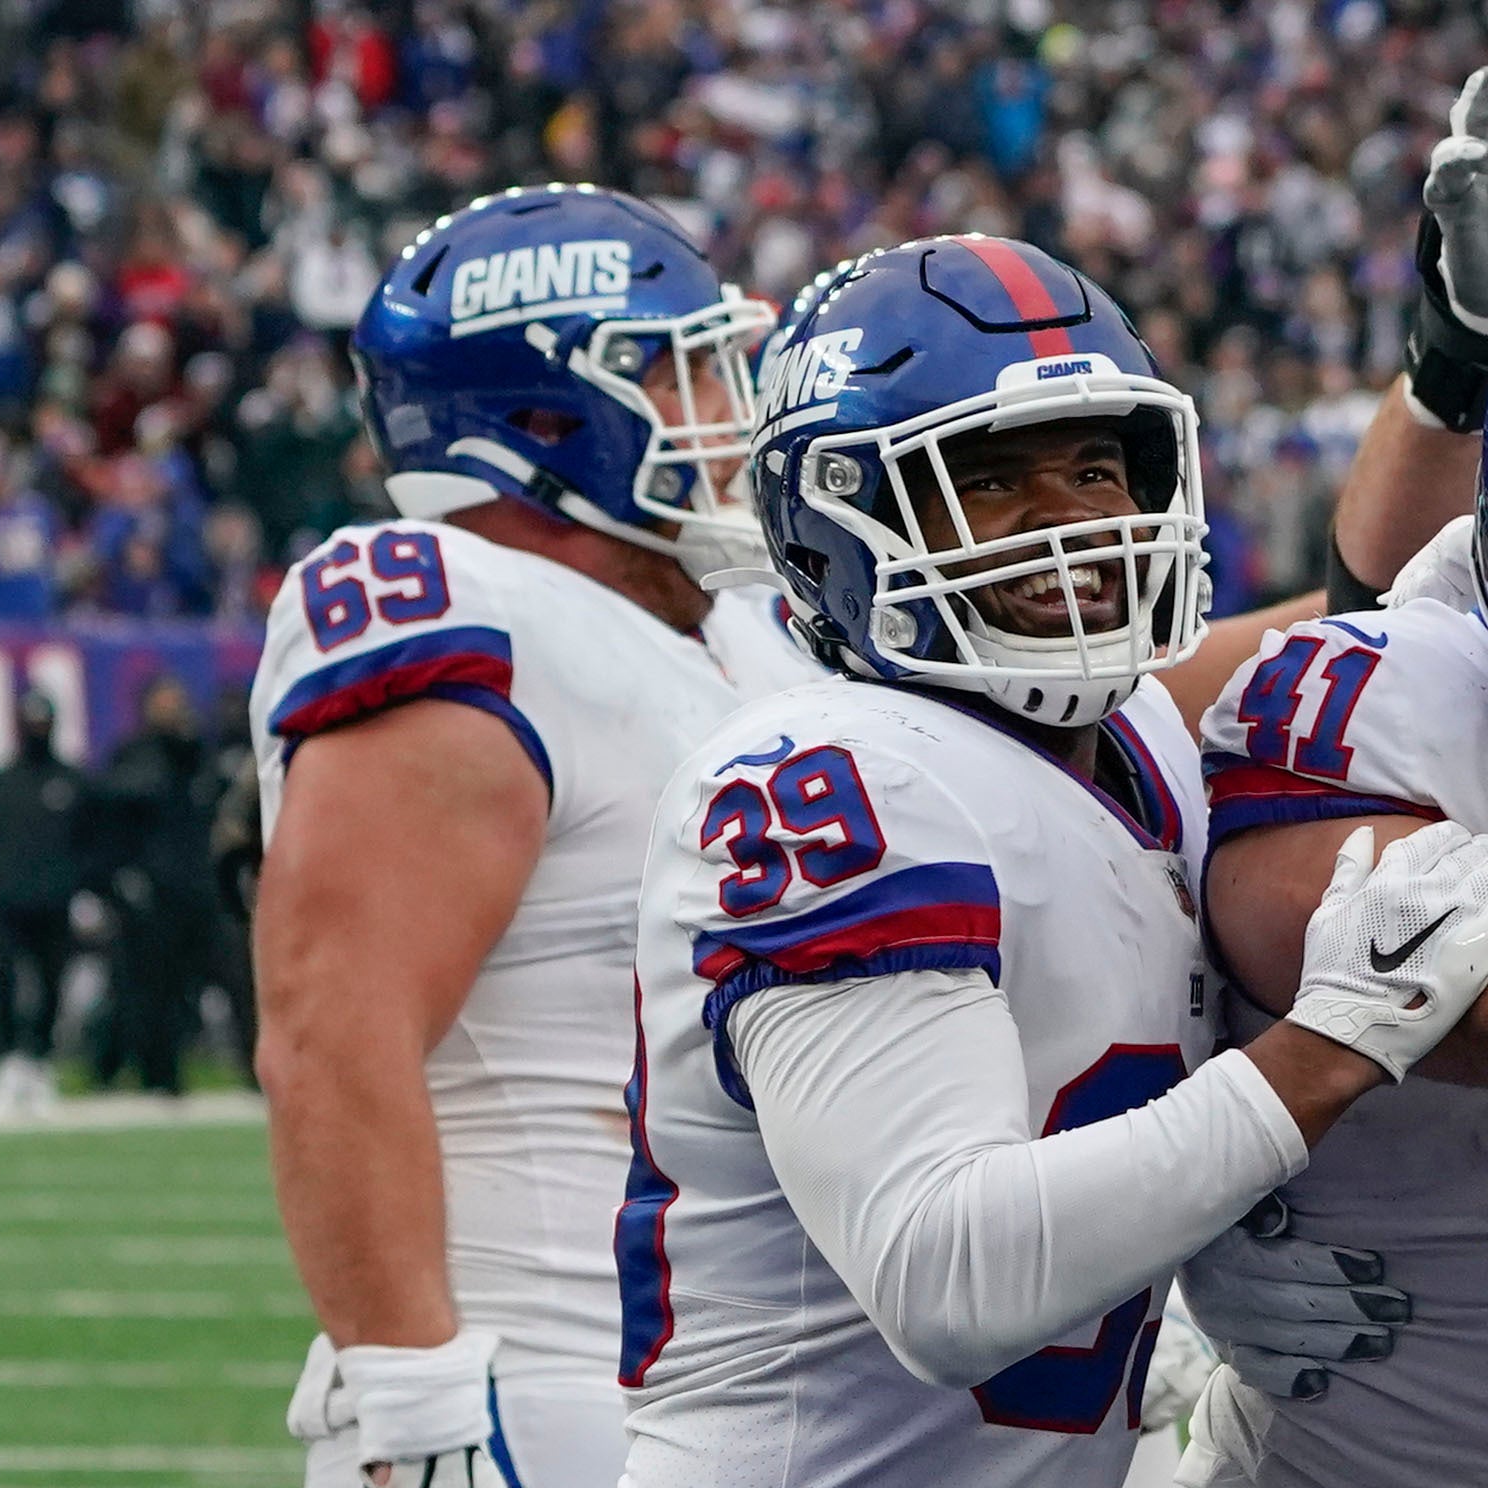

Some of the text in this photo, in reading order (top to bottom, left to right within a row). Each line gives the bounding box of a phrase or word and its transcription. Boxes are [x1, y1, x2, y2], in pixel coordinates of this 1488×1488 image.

[450, 240, 632, 320] GIANTS
[1037, 360, 1093, 380] GIANTS
[300, 530, 455, 654] 69
[1237, 635, 1381, 781] 41
[700, 744, 887, 918] 39
